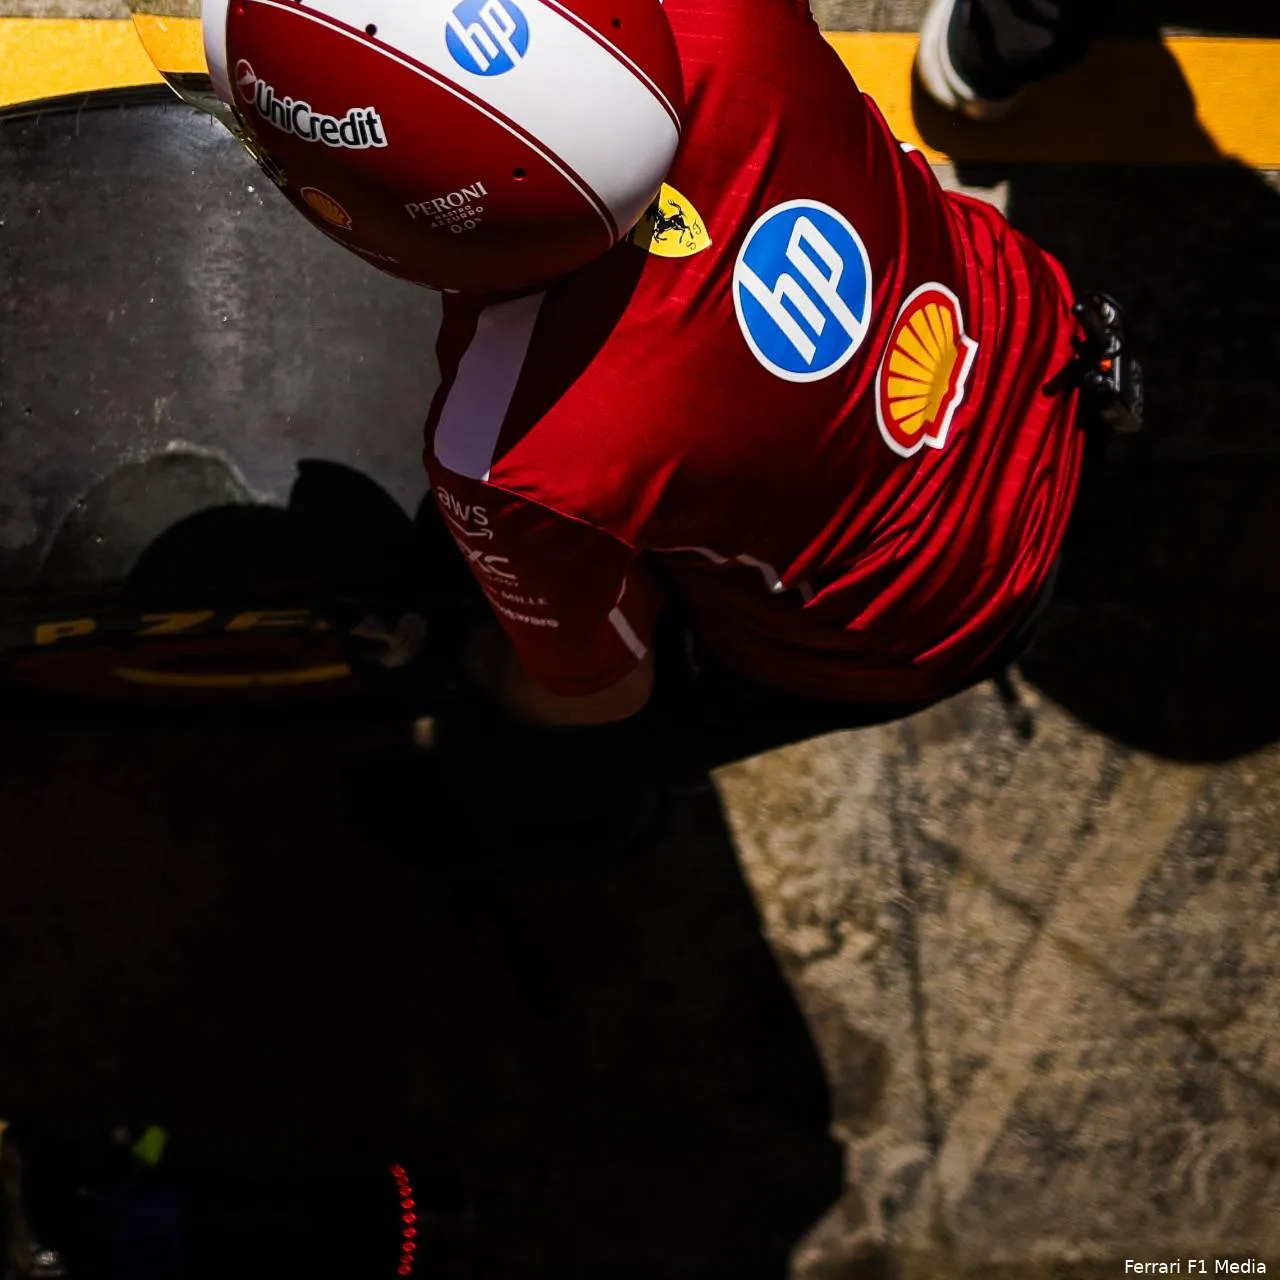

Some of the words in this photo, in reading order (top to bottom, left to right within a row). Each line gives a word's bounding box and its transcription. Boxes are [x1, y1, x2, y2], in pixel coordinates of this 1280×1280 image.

[257, 81, 388, 147] UniCredit
[404, 181, 488, 219] PERONI
[736, 215, 864, 366] hp
[437, 485, 490, 526] aws
